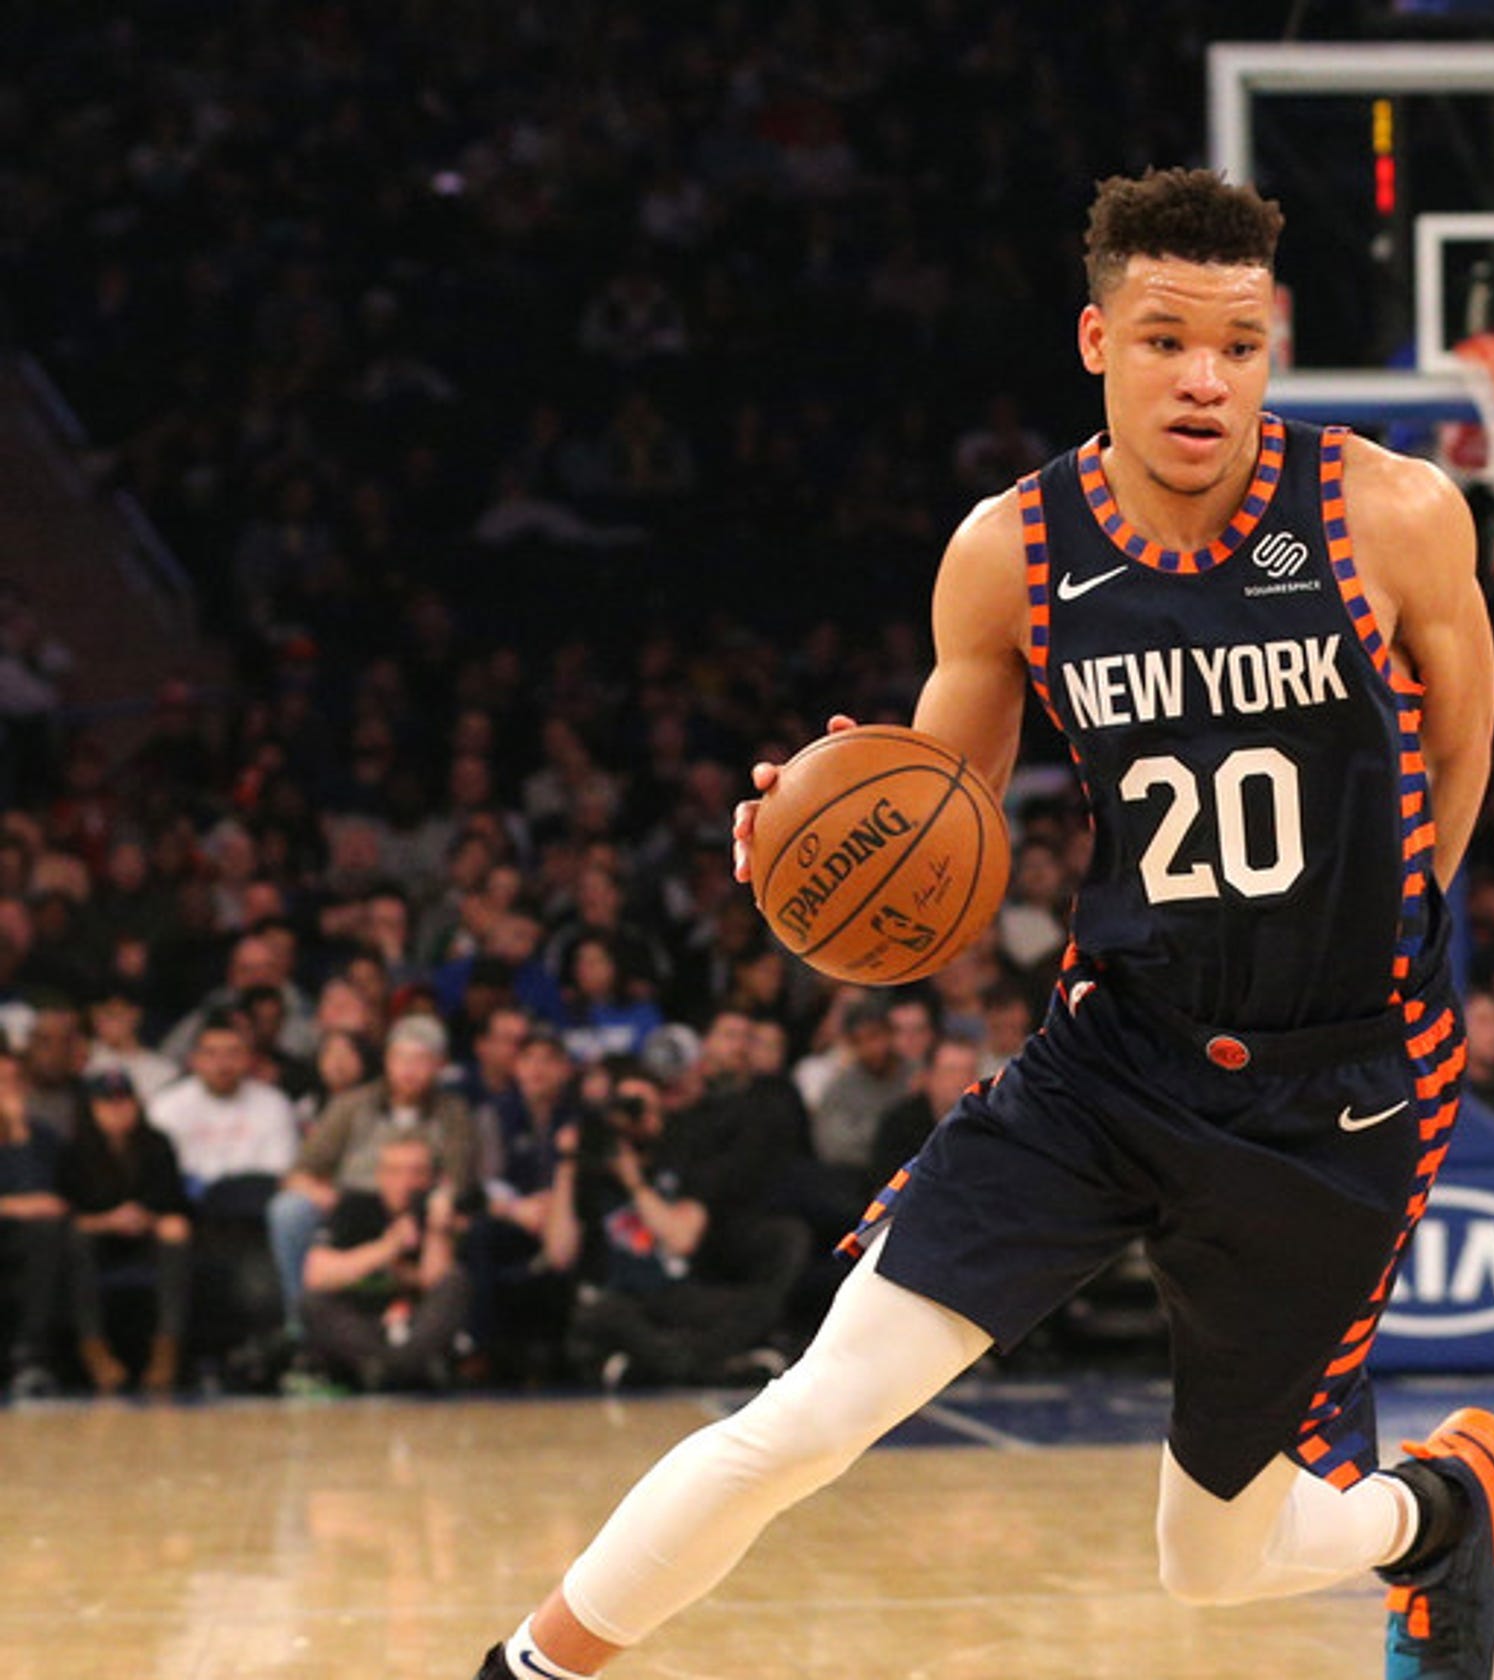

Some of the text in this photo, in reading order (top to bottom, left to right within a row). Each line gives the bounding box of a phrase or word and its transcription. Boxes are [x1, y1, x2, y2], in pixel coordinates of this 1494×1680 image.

[1062, 634, 1349, 729] NEW YORK
[777, 797, 912, 942] SPALDING
[1119, 747, 1304, 904] 20
